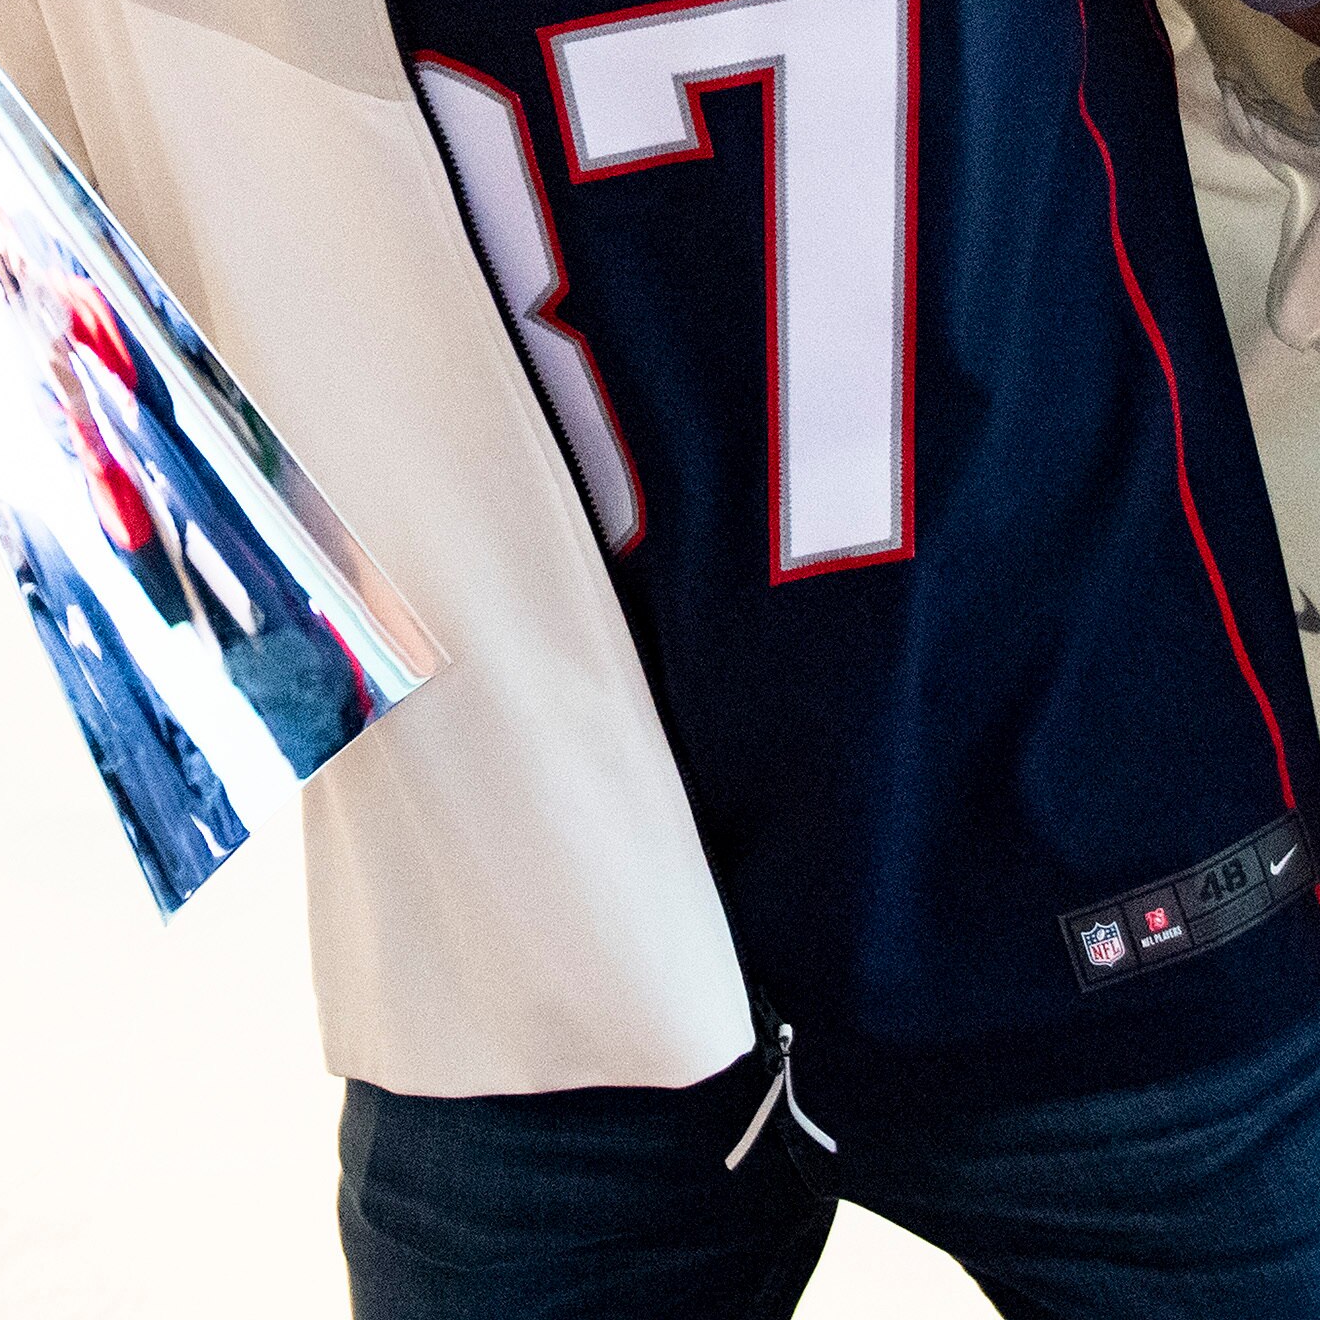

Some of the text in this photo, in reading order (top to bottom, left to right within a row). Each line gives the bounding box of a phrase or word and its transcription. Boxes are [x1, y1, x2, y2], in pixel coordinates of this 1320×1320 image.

[1201, 857, 1247, 901] 48
[1091, 940, 1121, 962] NFL
[1141, 935, 1155, 948] NFL
